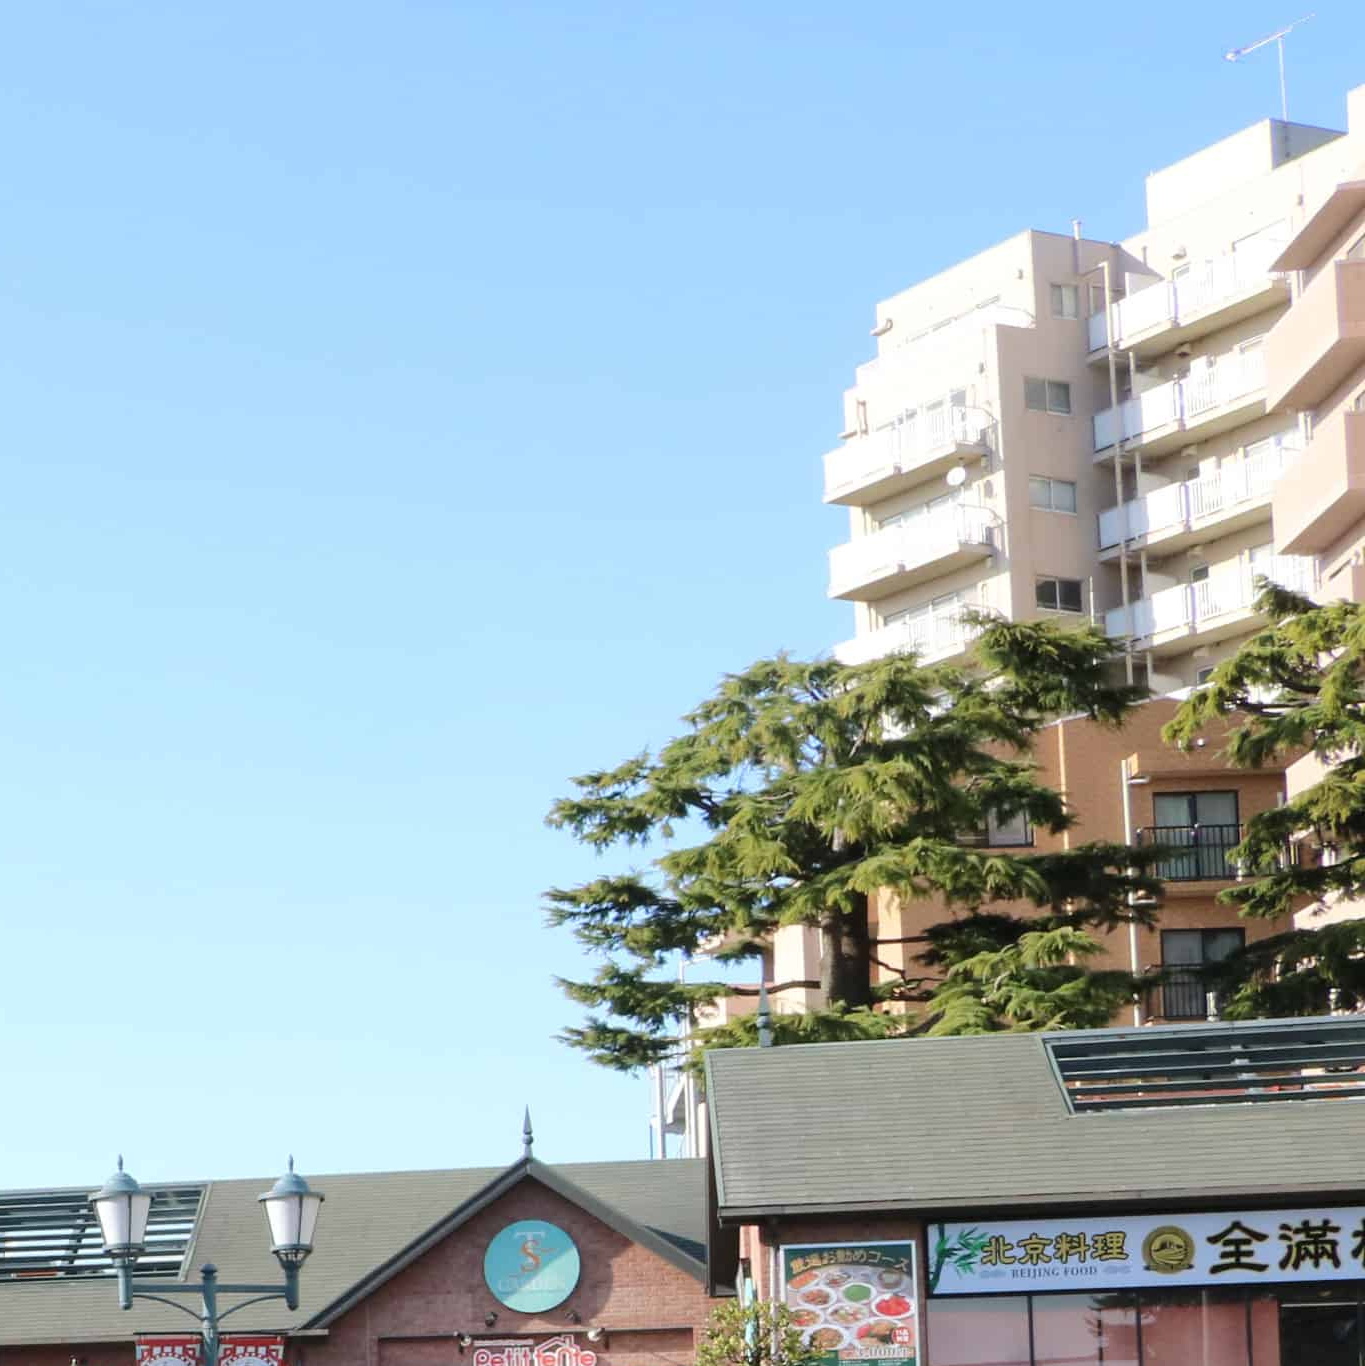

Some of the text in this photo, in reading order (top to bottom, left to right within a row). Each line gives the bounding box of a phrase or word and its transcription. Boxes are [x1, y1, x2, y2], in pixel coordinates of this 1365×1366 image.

[980, 1231, 1127, 1266] 北京料理
[1011, 1265, 1098, 1279] BEIJING FOOD
